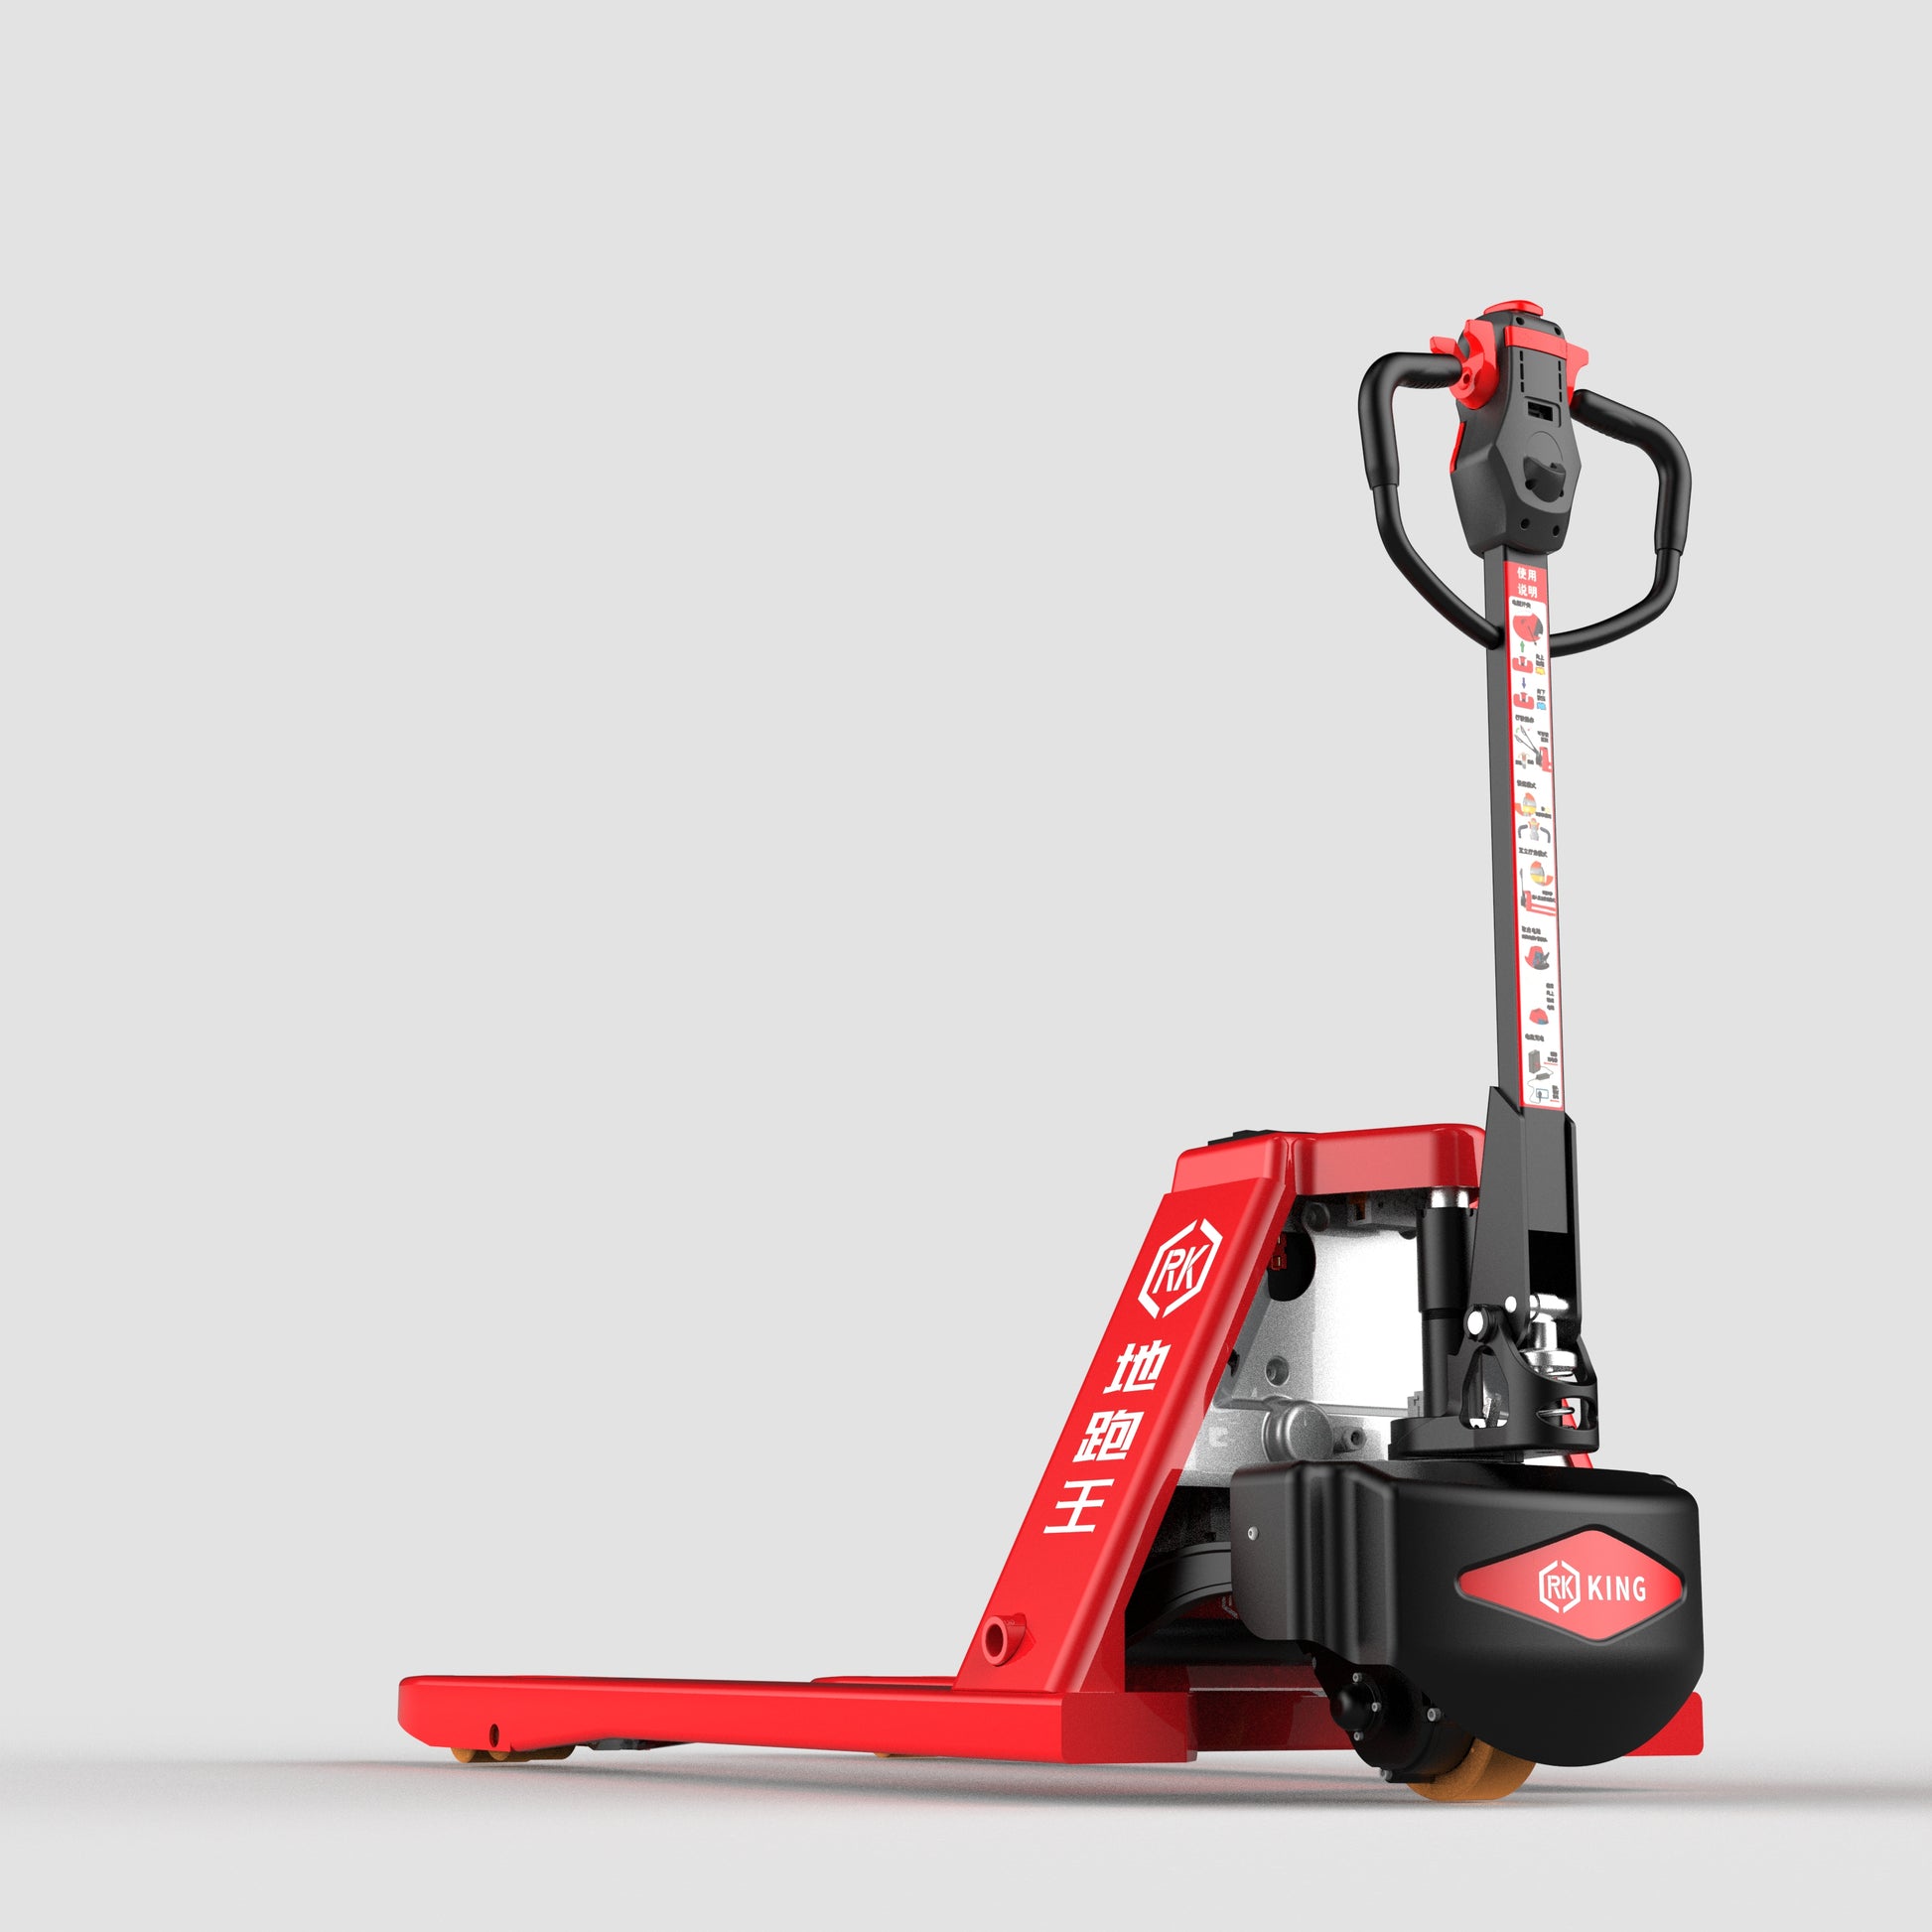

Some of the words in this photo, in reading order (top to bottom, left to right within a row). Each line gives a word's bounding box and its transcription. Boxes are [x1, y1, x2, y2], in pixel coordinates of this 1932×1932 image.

[1517, 567, 1537, 582] 使用
[1517, 583, 1538, 599] 说明
[1152, 1243, 1210, 1295] RK
[1042, 1339, 1172, 1534] 地跑王
[1547, 1575, 1575, 1599] RK
[1587, 1575, 1646, 1601] KING
